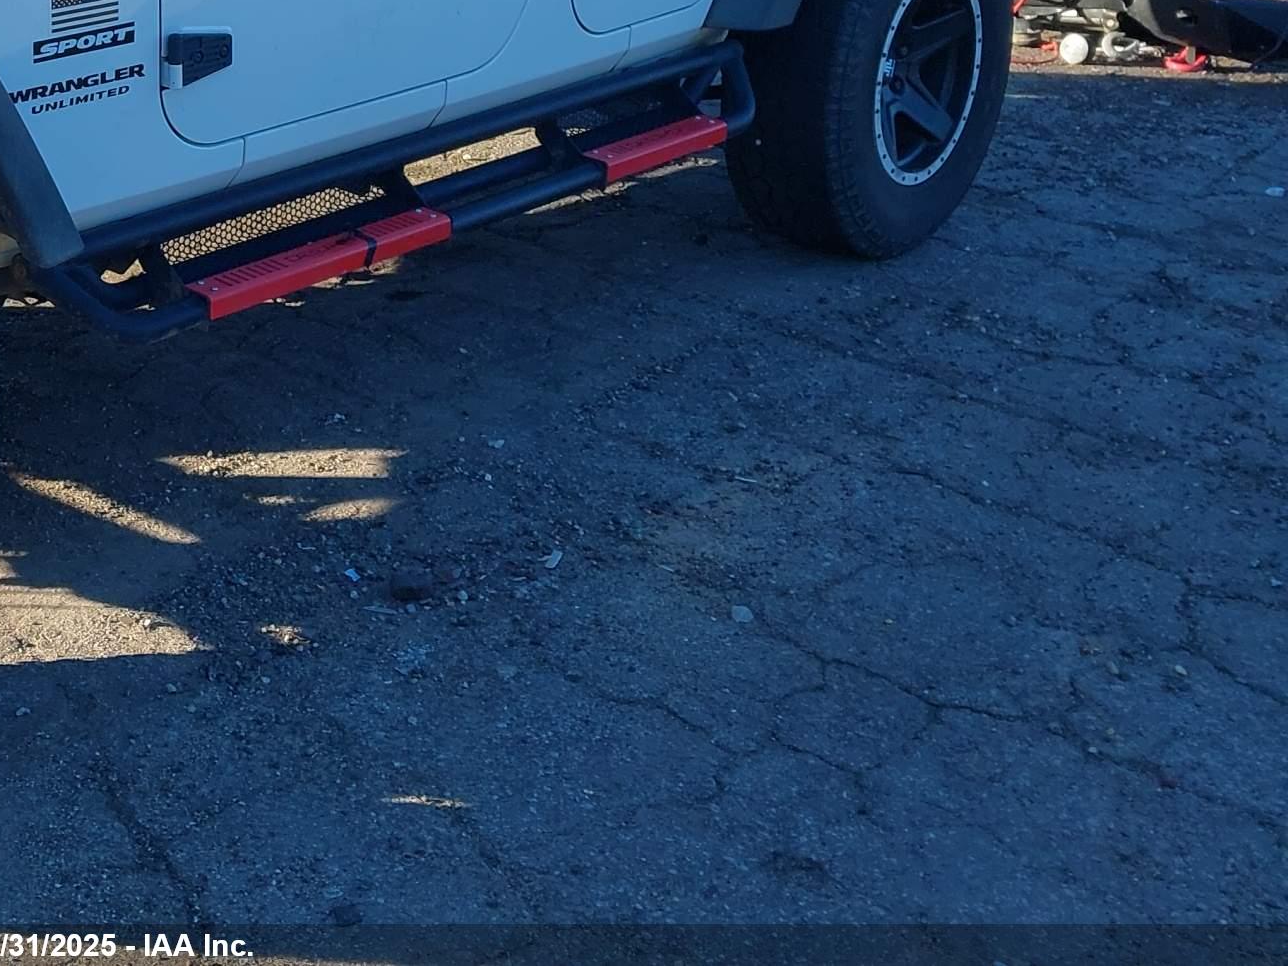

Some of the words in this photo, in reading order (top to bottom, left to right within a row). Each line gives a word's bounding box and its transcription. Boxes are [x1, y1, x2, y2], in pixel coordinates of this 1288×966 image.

[39, 28, 129, 56] SPORT
[9, 64, 145, 104] WRANGLER
[31, 85, 130, 115] UNLIMITED
